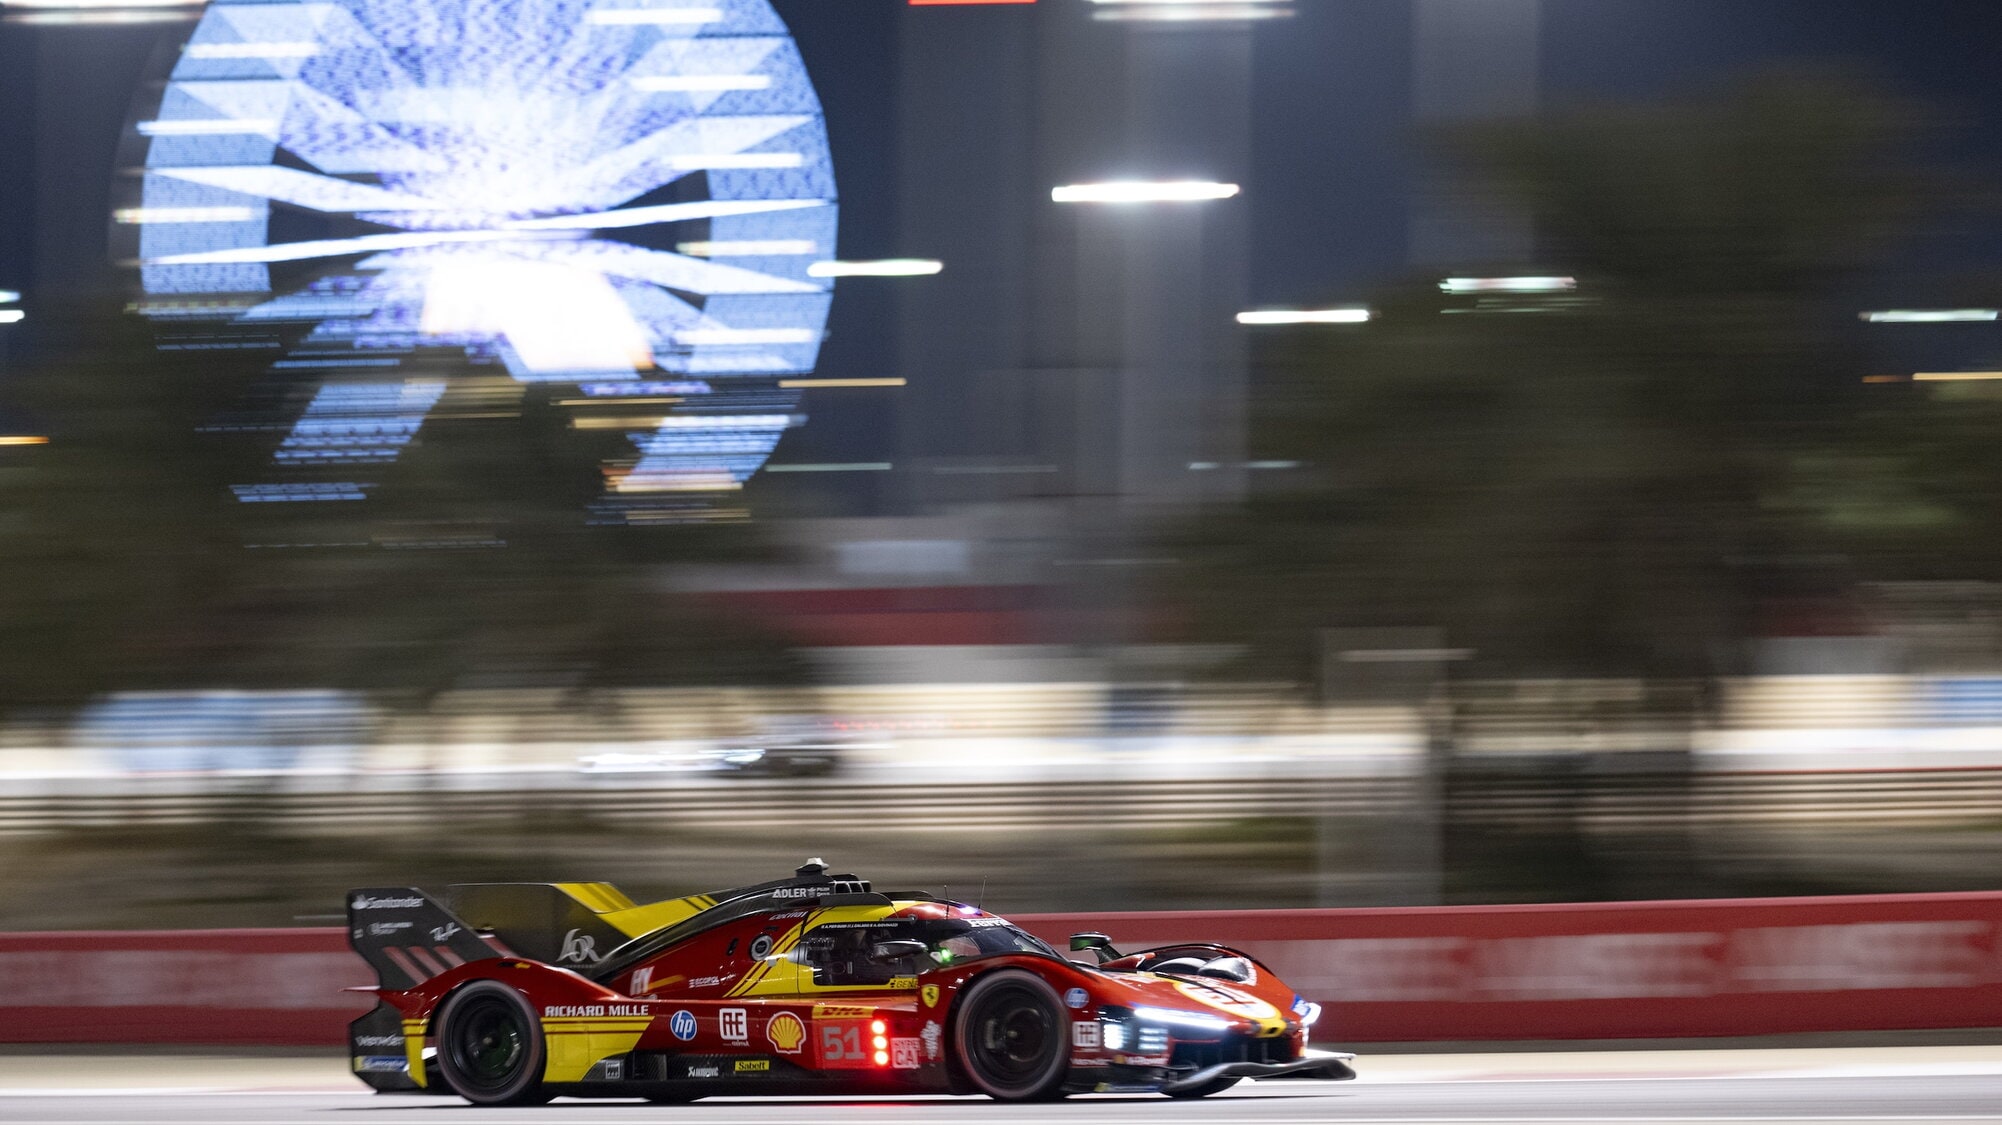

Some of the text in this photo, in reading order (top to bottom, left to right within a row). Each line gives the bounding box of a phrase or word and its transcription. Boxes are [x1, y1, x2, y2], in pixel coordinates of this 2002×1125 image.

[772, 888, 807, 898] ADLER
[545, 1004, 649, 1017] RICHARD MILLE
[675, 1011, 694, 1040] hp
[823, 1027, 866, 1060] 51
[739, 1060, 766, 1071] Sabelt
